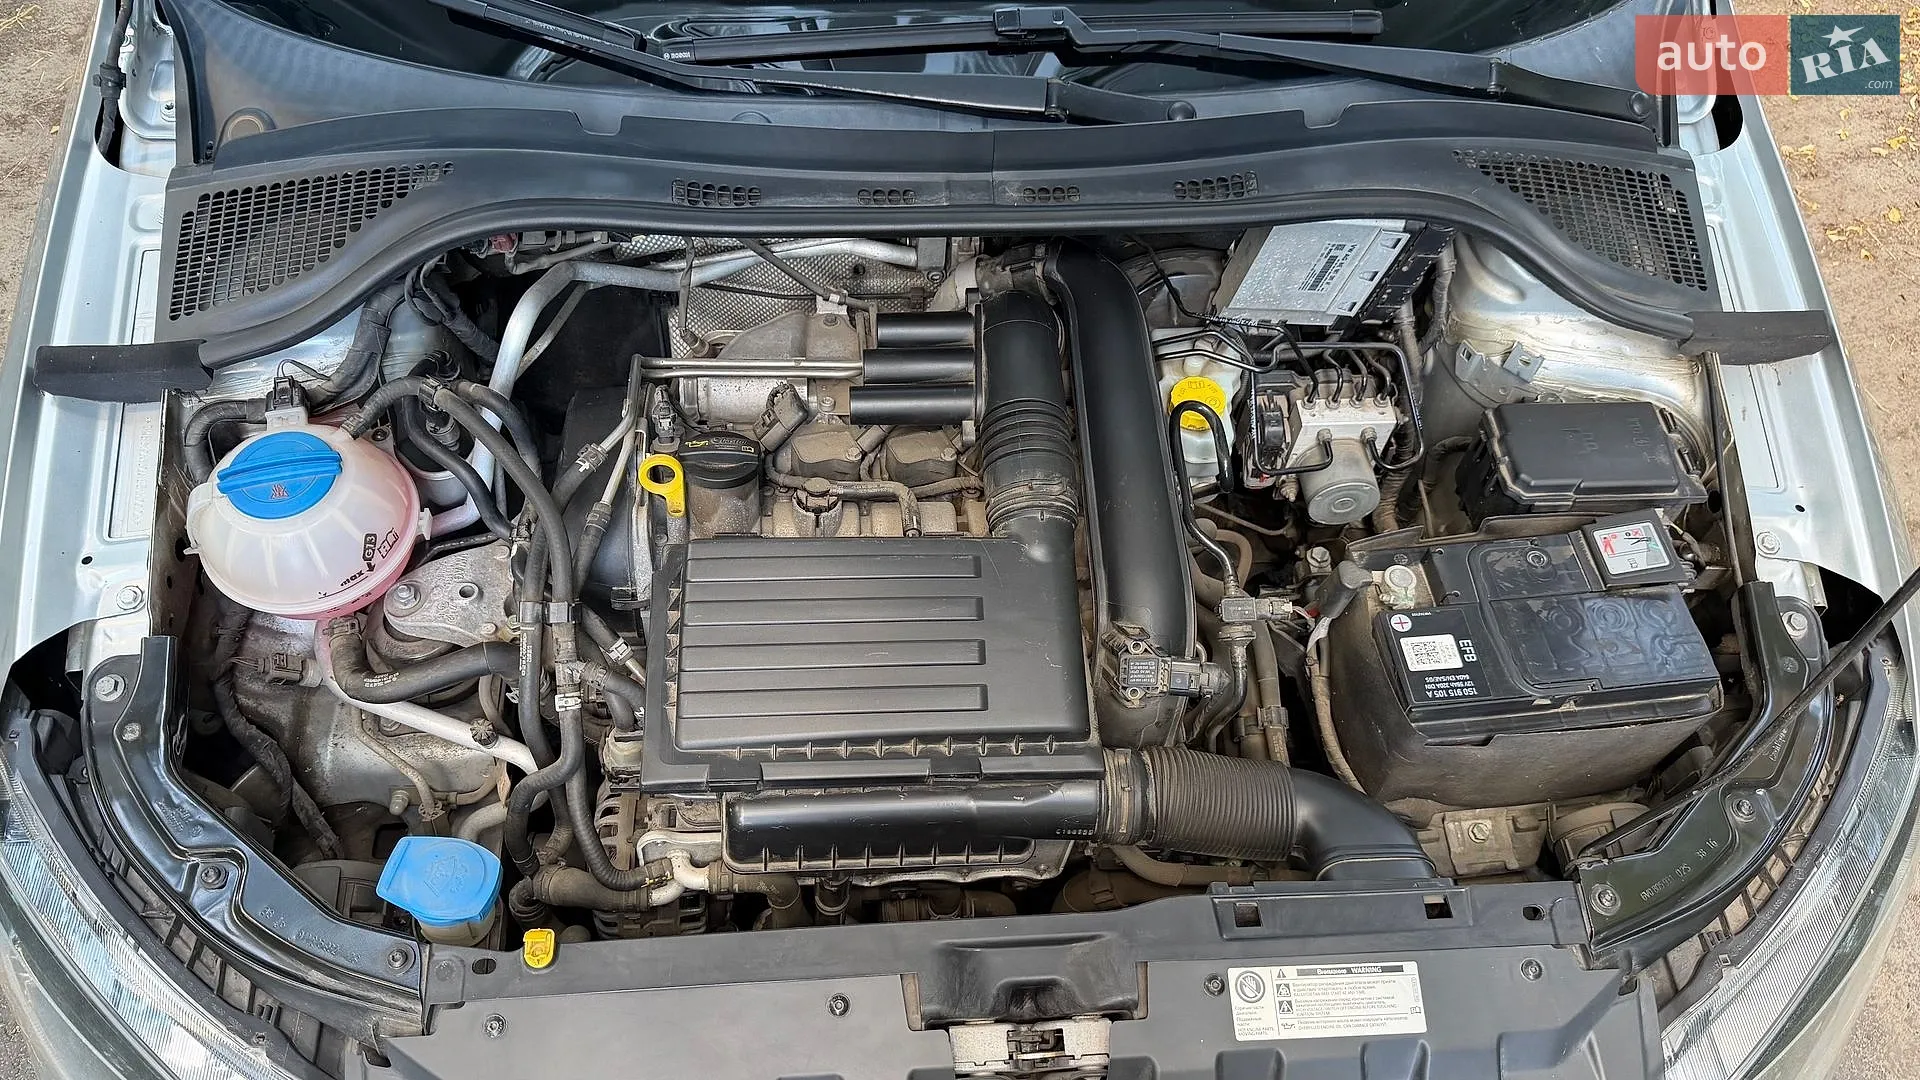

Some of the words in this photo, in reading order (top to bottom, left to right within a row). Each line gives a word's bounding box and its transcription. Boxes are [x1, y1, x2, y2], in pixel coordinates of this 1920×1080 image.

[365, 536, 376, 558] G13
[340, 570, 365, 586] max
[1459, 639, 1477, 662] EFB
[1425, 690, 1433, 698] A
[1433, 690, 1448, 698] 105
[1449, 689, 1463, 697] 915
[1351, 966, 1382, 974] WARNING
